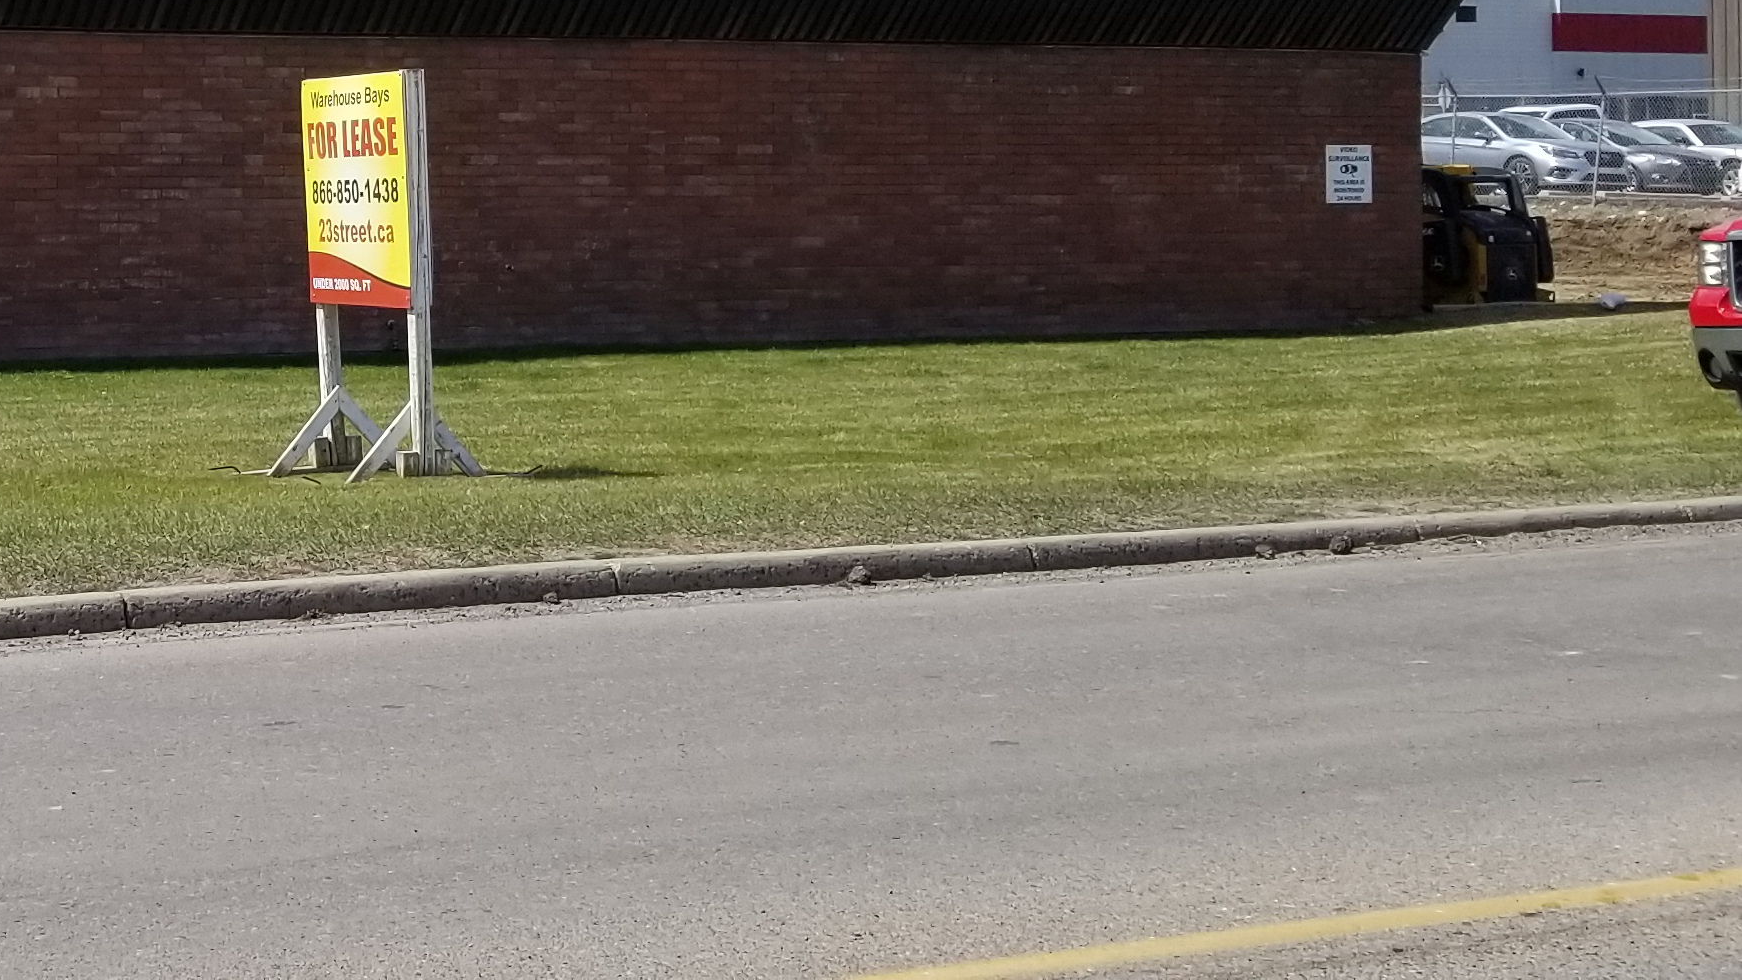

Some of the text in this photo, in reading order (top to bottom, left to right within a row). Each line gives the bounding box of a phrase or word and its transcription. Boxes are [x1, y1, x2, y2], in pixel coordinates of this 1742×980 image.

[310, 87, 390, 109] Warehouse Bays
[307, 117, 399, 160] FOR LEASE
[312, 177, 399, 205] 866-850-1438
[318, 218, 395, 243] 23street.ca
[312, 277, 334, 290] UNDER
[334, 278, 350, 291] 2000
[362, 279, 372, 292] FT
